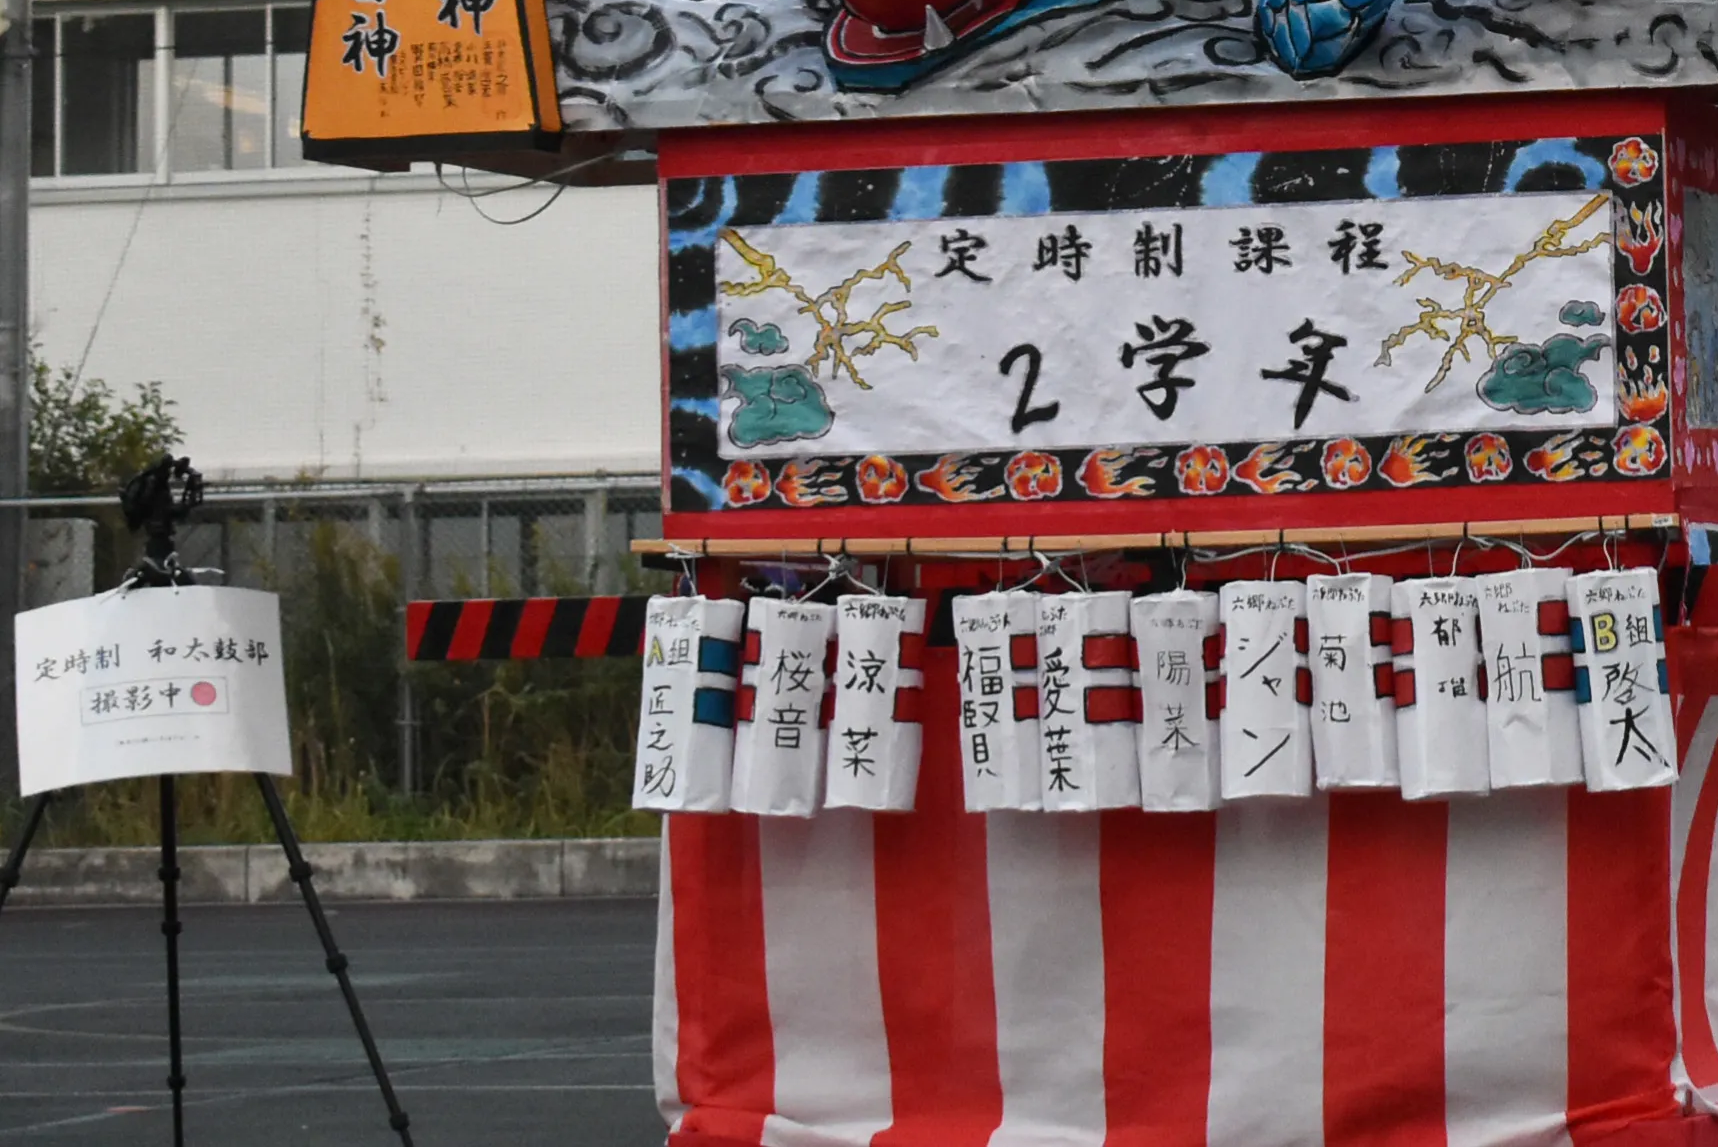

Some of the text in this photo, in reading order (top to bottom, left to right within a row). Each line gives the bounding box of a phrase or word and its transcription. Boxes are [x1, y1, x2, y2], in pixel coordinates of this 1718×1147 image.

[935, 217, 1392, 282] 定時制課程
[1000, 315, 1357, 433] 2学年
[34, 637, 270, 682] 定時制 和太鼓部
[647, 635, 693, 667] A組
[1319, 634, 1351, 722] 菊池
[1494, 642, 1541, 703] 航
[1592, 612, 1653, 653] B組
[90, 682, 182, 714] 撮影中
[641, 684, 676, 798] 匠之助
[768, 649, 815, 748] 桜音
[841, 650, 885, 778] 涼菜
[1043, 647, 1080, 791] 愛葉
[1156, 650, 1199, 751] 陽菜
[1238, 632, 1290, 777] ジャン
[1602, 661, 1671, 767] 啓太
